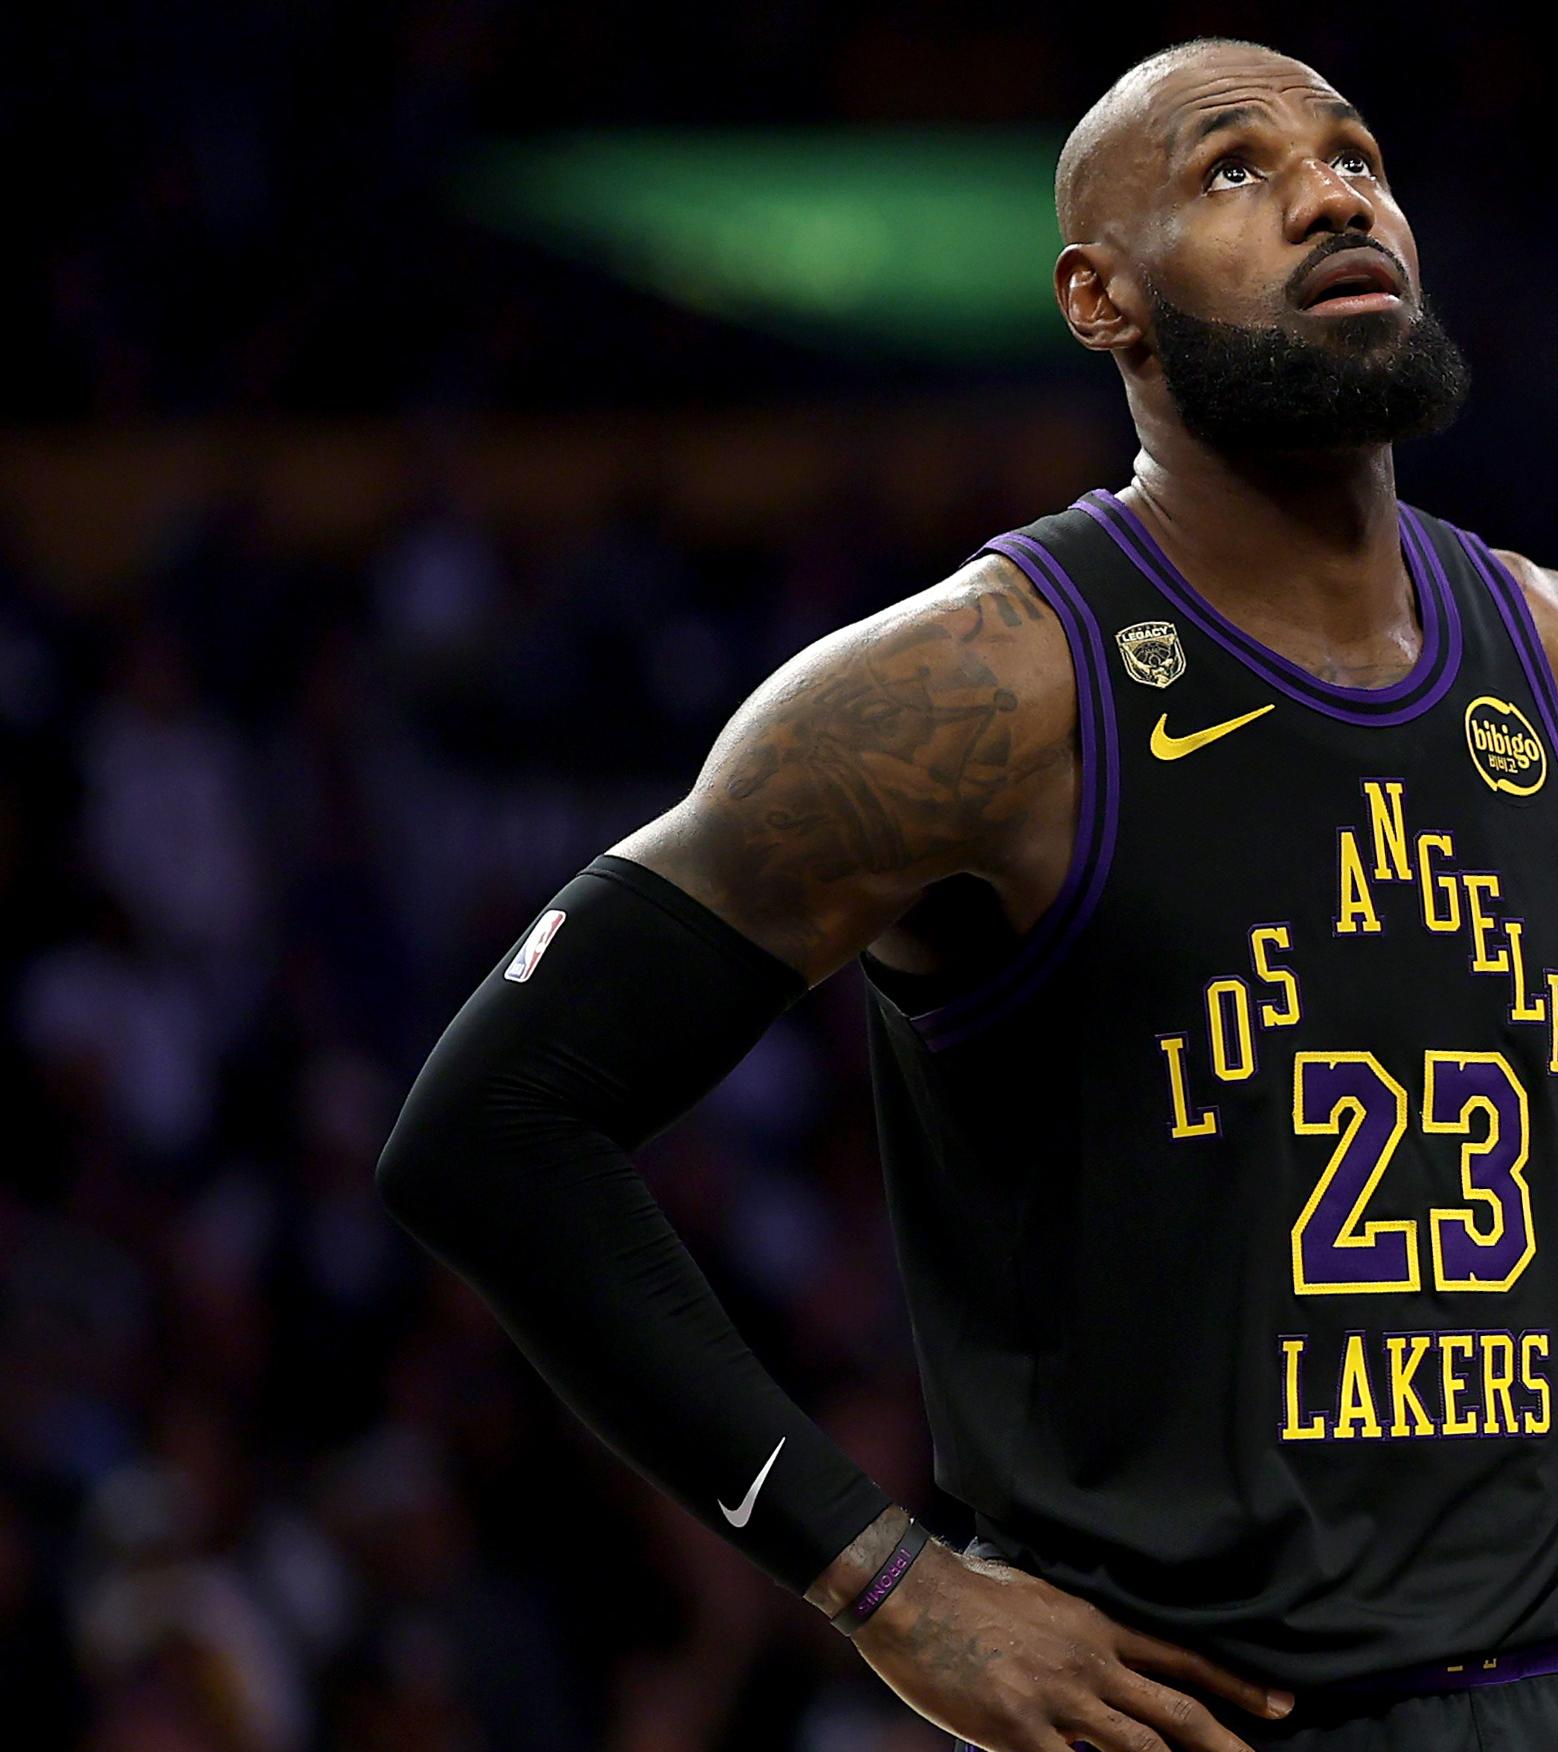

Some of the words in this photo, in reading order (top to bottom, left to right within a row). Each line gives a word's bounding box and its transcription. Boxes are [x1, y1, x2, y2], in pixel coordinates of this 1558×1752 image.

[1122, 628, 1169, 641] LEGACY
[1472, 720, 1540, 769] bibigo
[1488, 755, 1518, 774] 비비고
[1159, 926, 1301, 1139] LOS
[1292, 1051, 1536, 1294] 23
[1281, 1332, 1551, 1441] LAKERS
